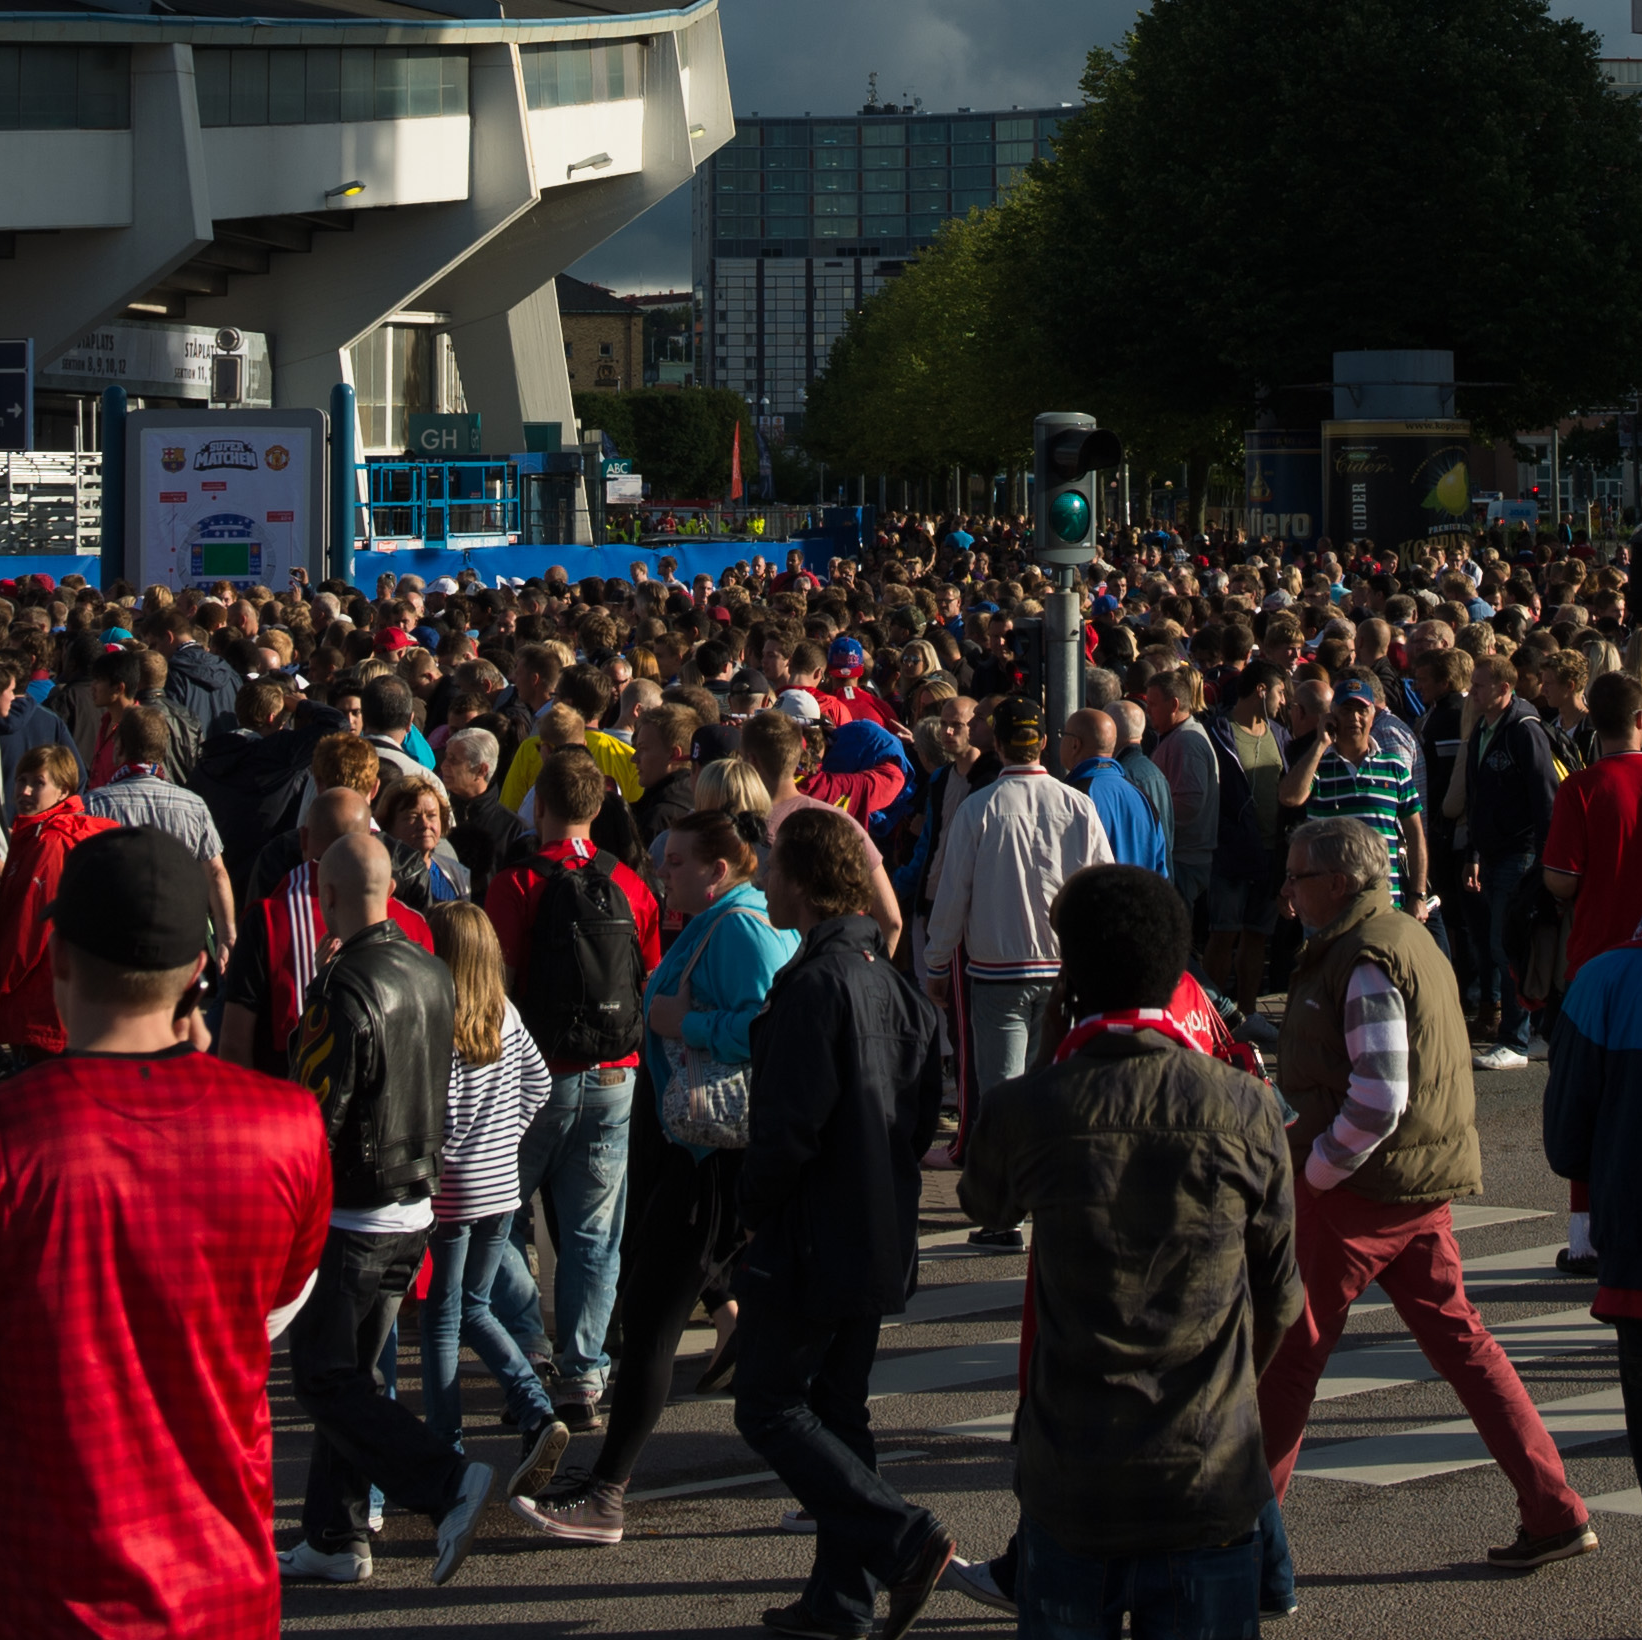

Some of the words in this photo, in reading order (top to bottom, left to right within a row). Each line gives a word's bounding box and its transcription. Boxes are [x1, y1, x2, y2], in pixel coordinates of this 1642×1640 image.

[211, 441, 244, 452] SUPER
[421, 428, 457, 449] GH
[195, 450, 257, 468] MATCHEN
[606, 462, 628, 474] ABC
[1334, 451, 1389, 474] Cider
[1351, 482, 1367, 531] CIDER
